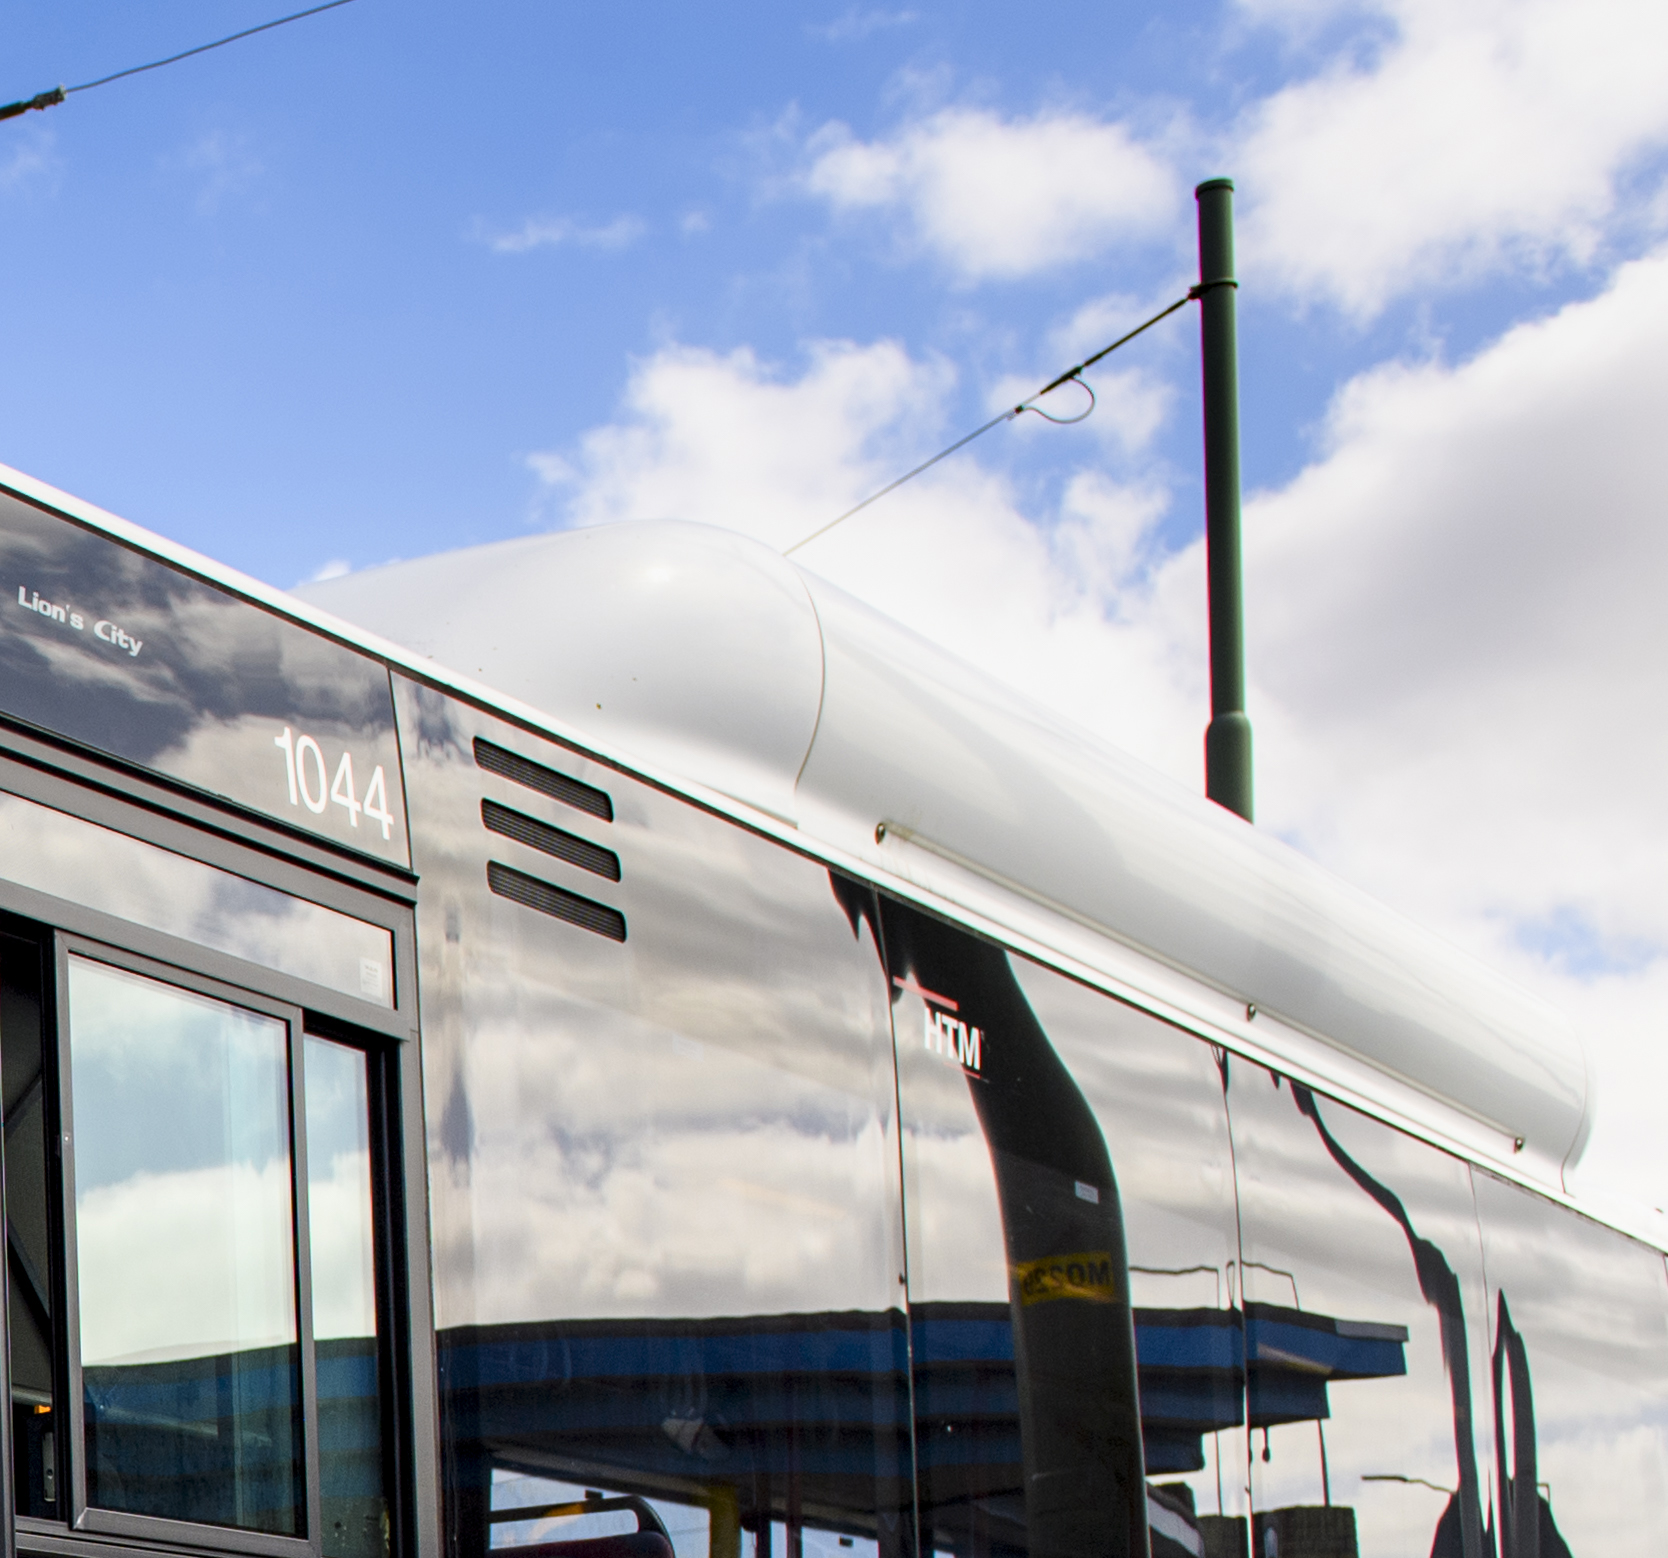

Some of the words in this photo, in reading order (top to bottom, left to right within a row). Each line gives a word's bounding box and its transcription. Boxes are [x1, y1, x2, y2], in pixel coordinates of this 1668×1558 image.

[18, 586, 84, 630] Lion's
[93, 620, 143, 657] City
[274, 726, 395, 841] 1044
[924, 1007, 982, 1071] HTM
